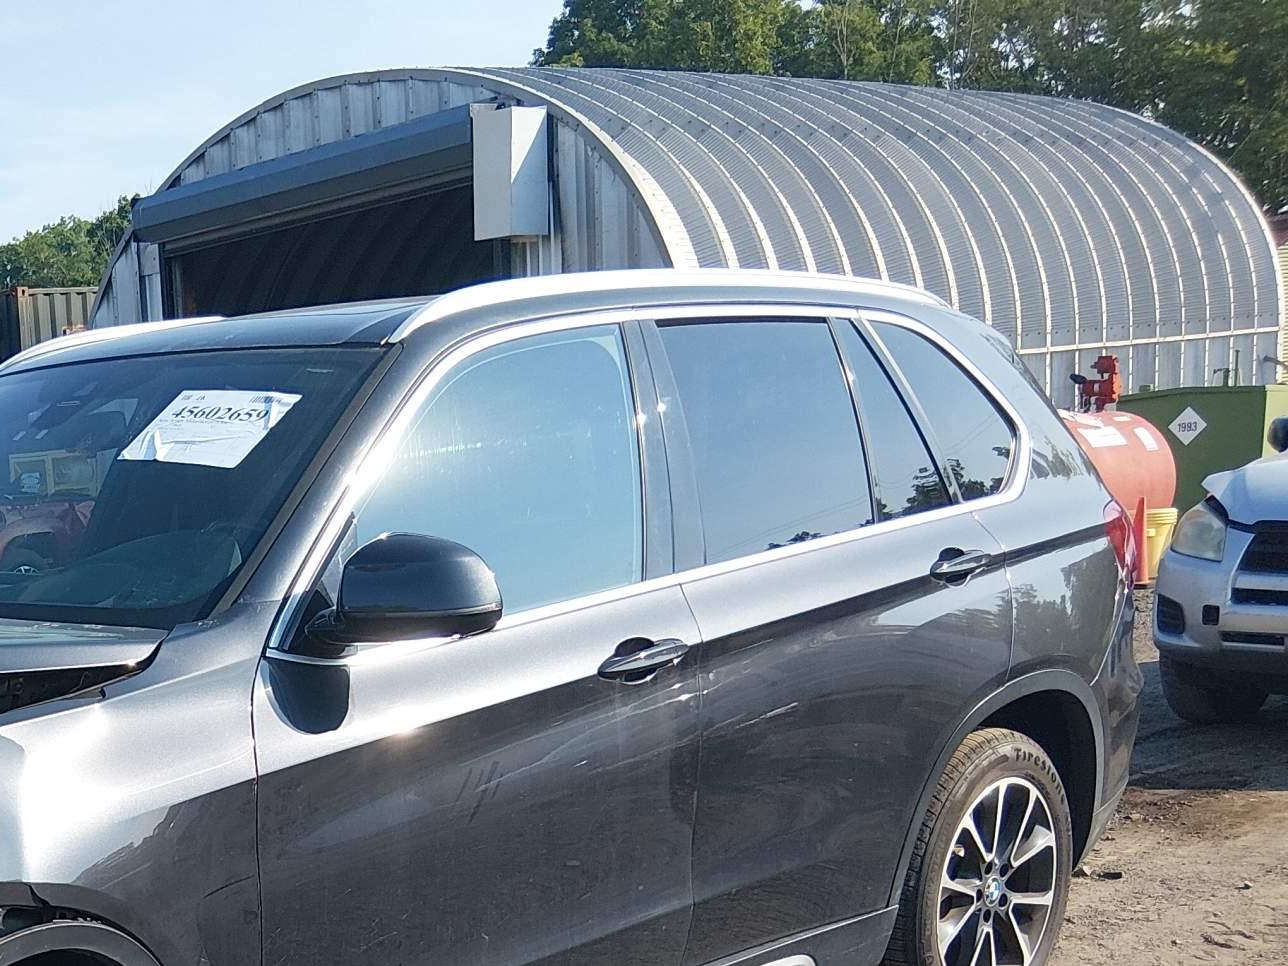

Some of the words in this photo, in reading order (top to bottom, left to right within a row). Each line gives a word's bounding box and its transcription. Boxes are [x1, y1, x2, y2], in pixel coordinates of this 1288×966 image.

[172, 406, 269, 421] 45602659
[1177, 421, 1198, 433] 1993
[1013, 747, 1065, 806] Firestone
